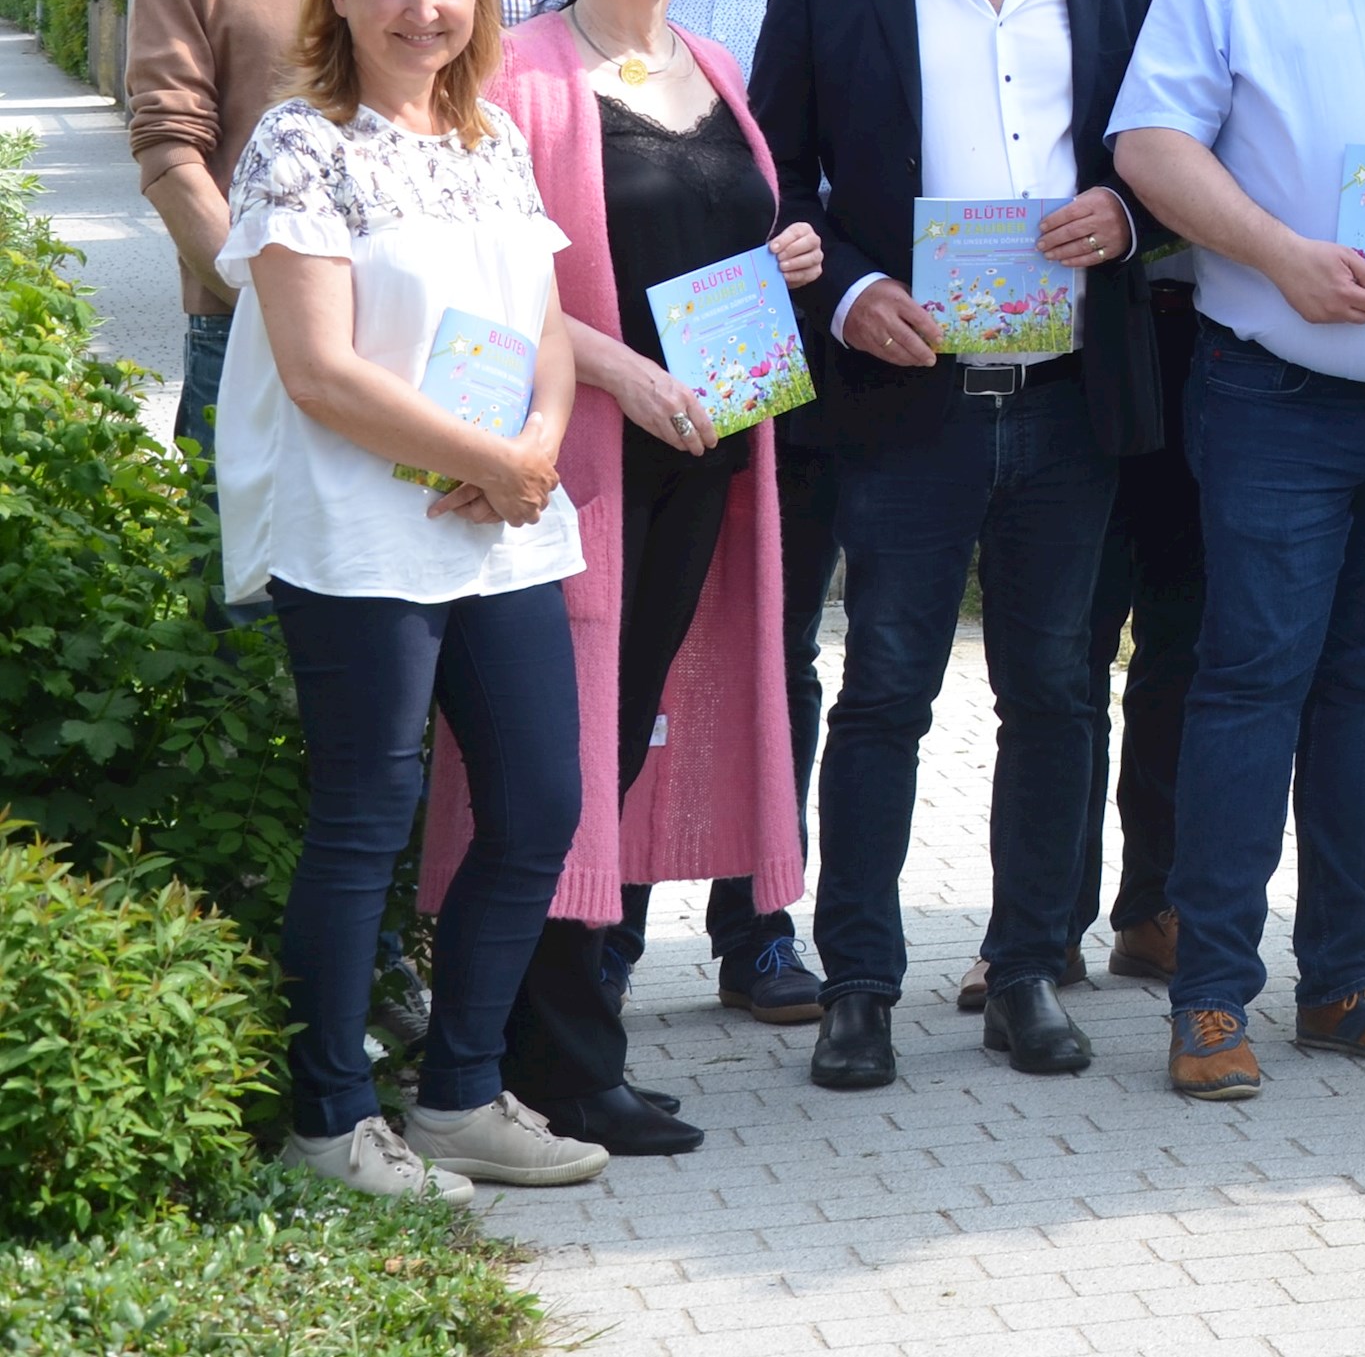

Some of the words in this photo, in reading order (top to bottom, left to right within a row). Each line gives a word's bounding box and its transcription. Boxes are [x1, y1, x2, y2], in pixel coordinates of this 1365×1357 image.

[964, 205, 1026, 220] BLÜTEN
[964, 222, 1026, 234] ZAUBER
[1000, 236, 1035, 244] DÖRFERN
[692, 264, 743, 294] BLÜTEN
[698, 281, 746, 308] ZAUBER
[489, 330, 527, 357] BLÜTEN
